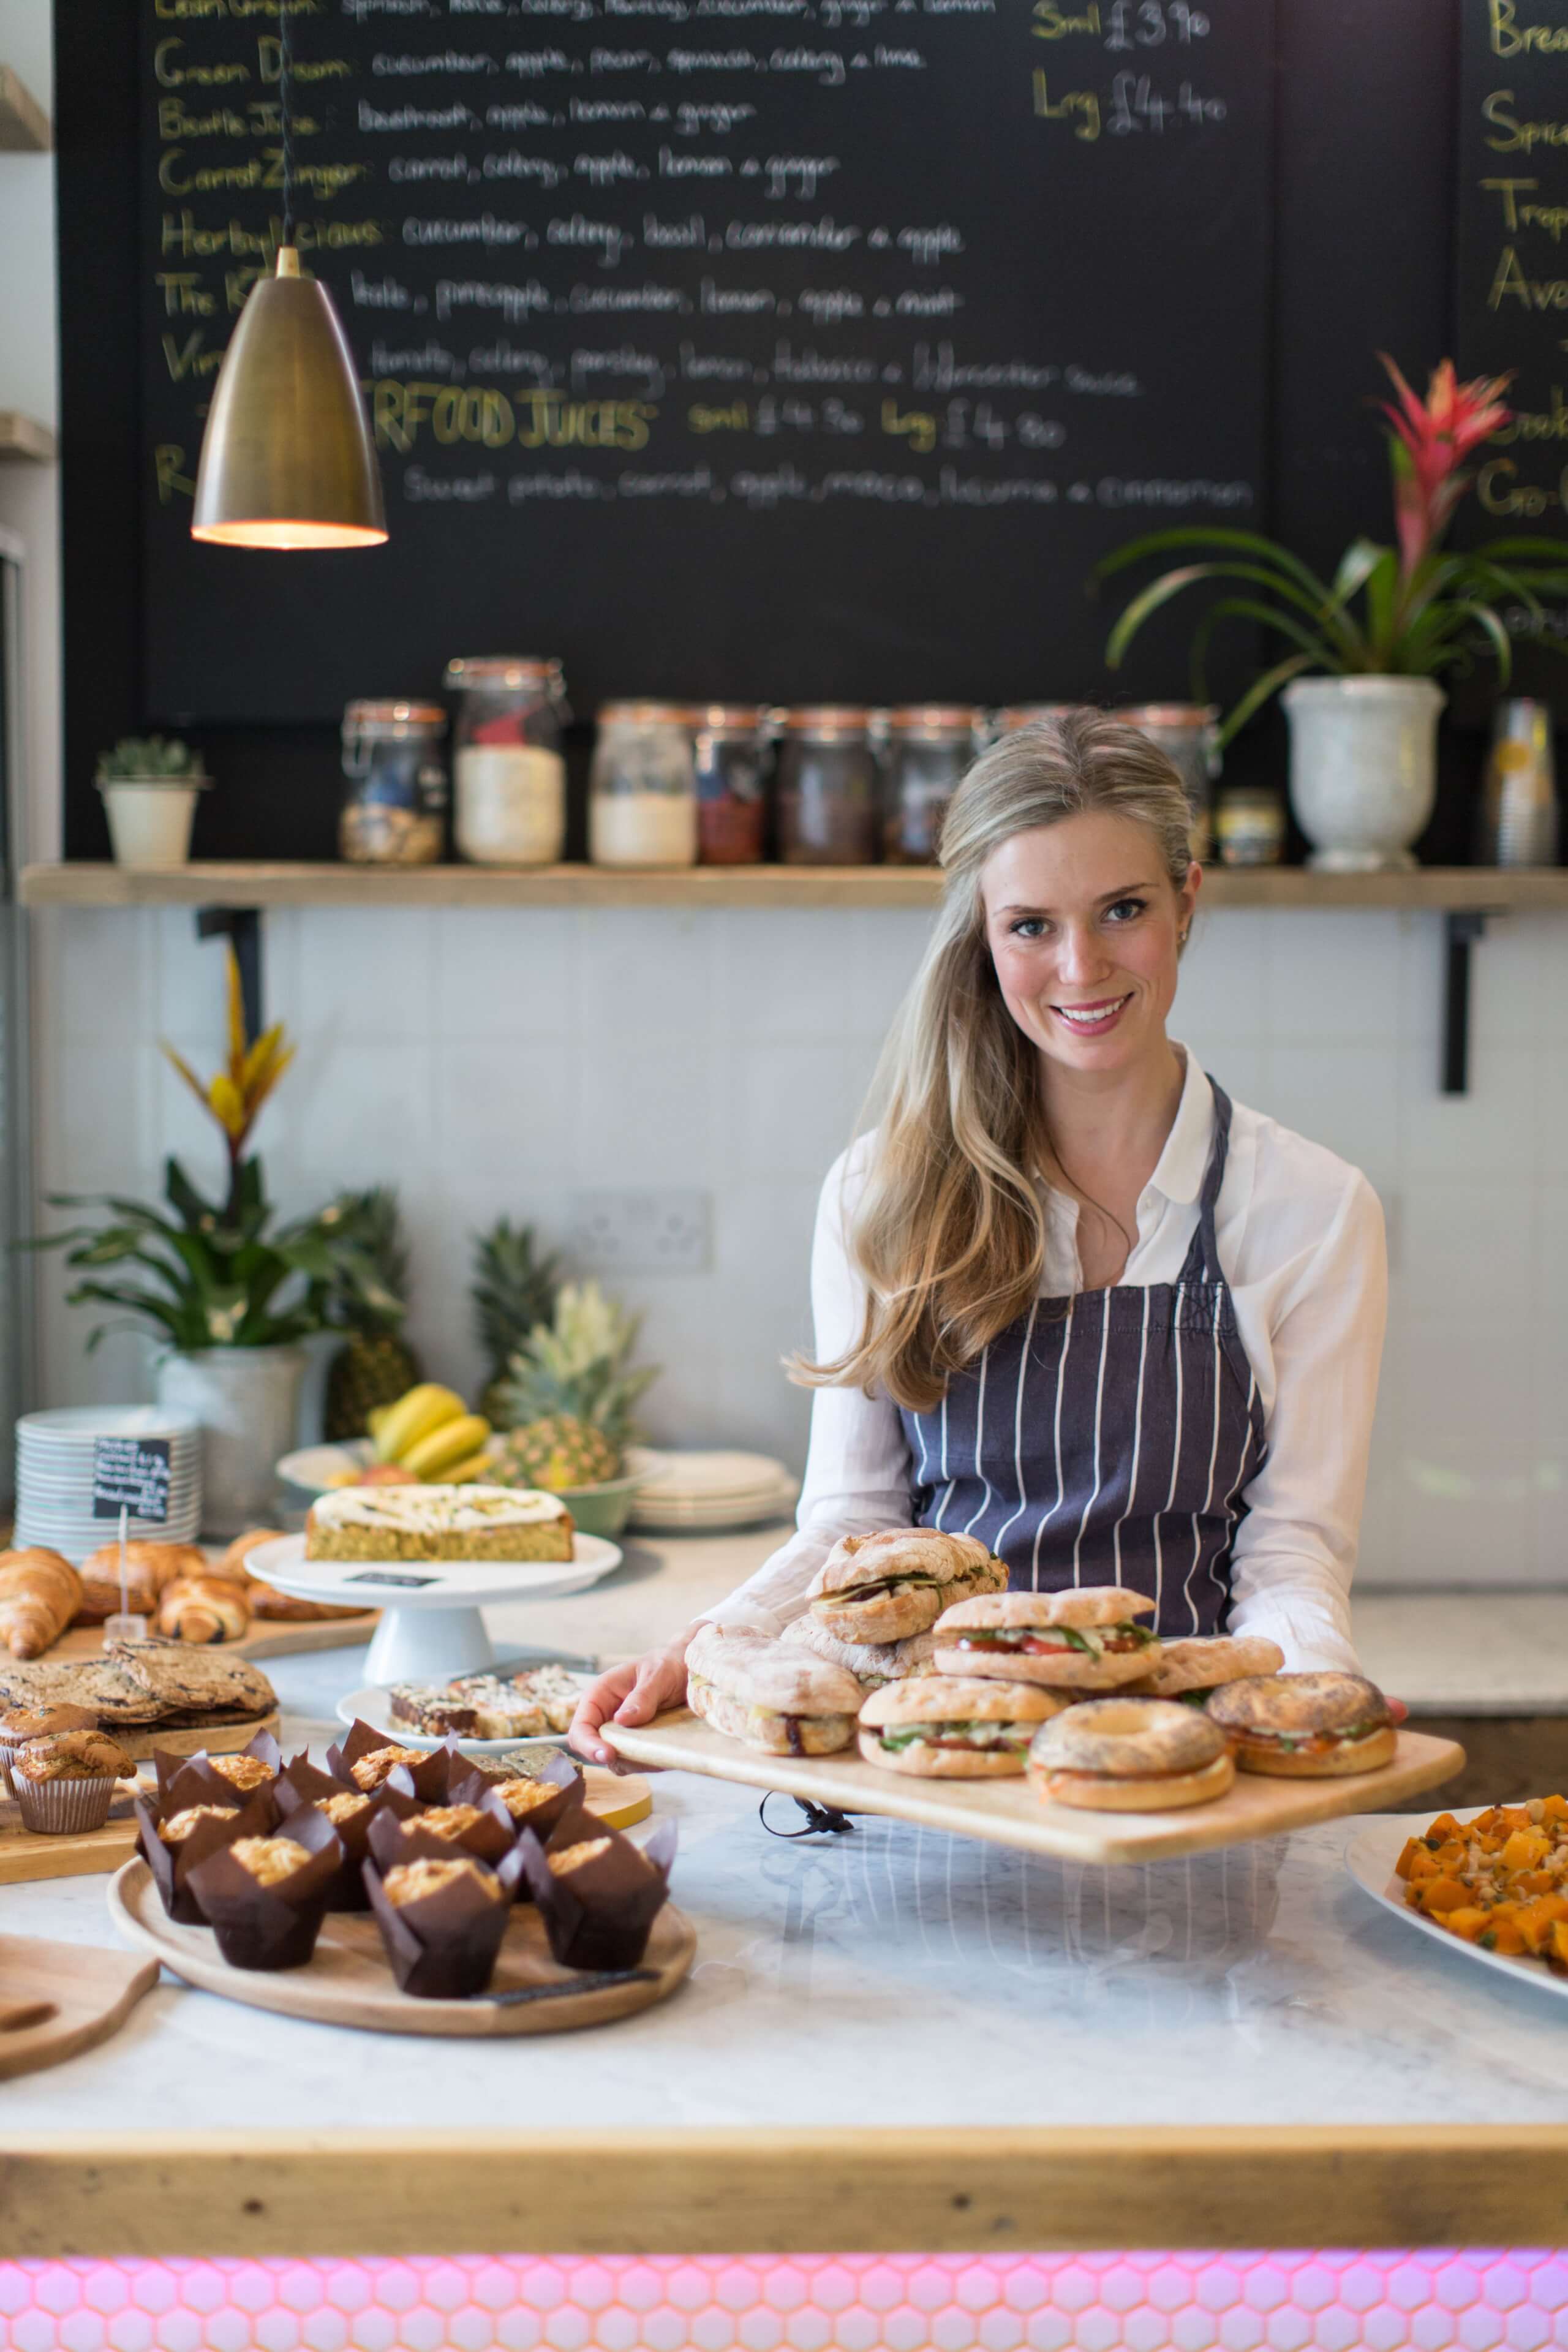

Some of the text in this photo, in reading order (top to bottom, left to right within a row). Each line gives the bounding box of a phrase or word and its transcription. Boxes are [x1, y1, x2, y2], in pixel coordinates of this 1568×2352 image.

[154, 36, 250, 88] Green
[570, 96, 646, 122] lemon
[673, 100, 758, 135] ginger
[159, 147, 262, 196] Carrot
[658, 144, 734, 178] lemon
[764, 153, 841, 200] ginger
[725, 216, 862, 252] coriander
[896, 222, 967, 265] apple
[797, 286, 864, 325] apple
